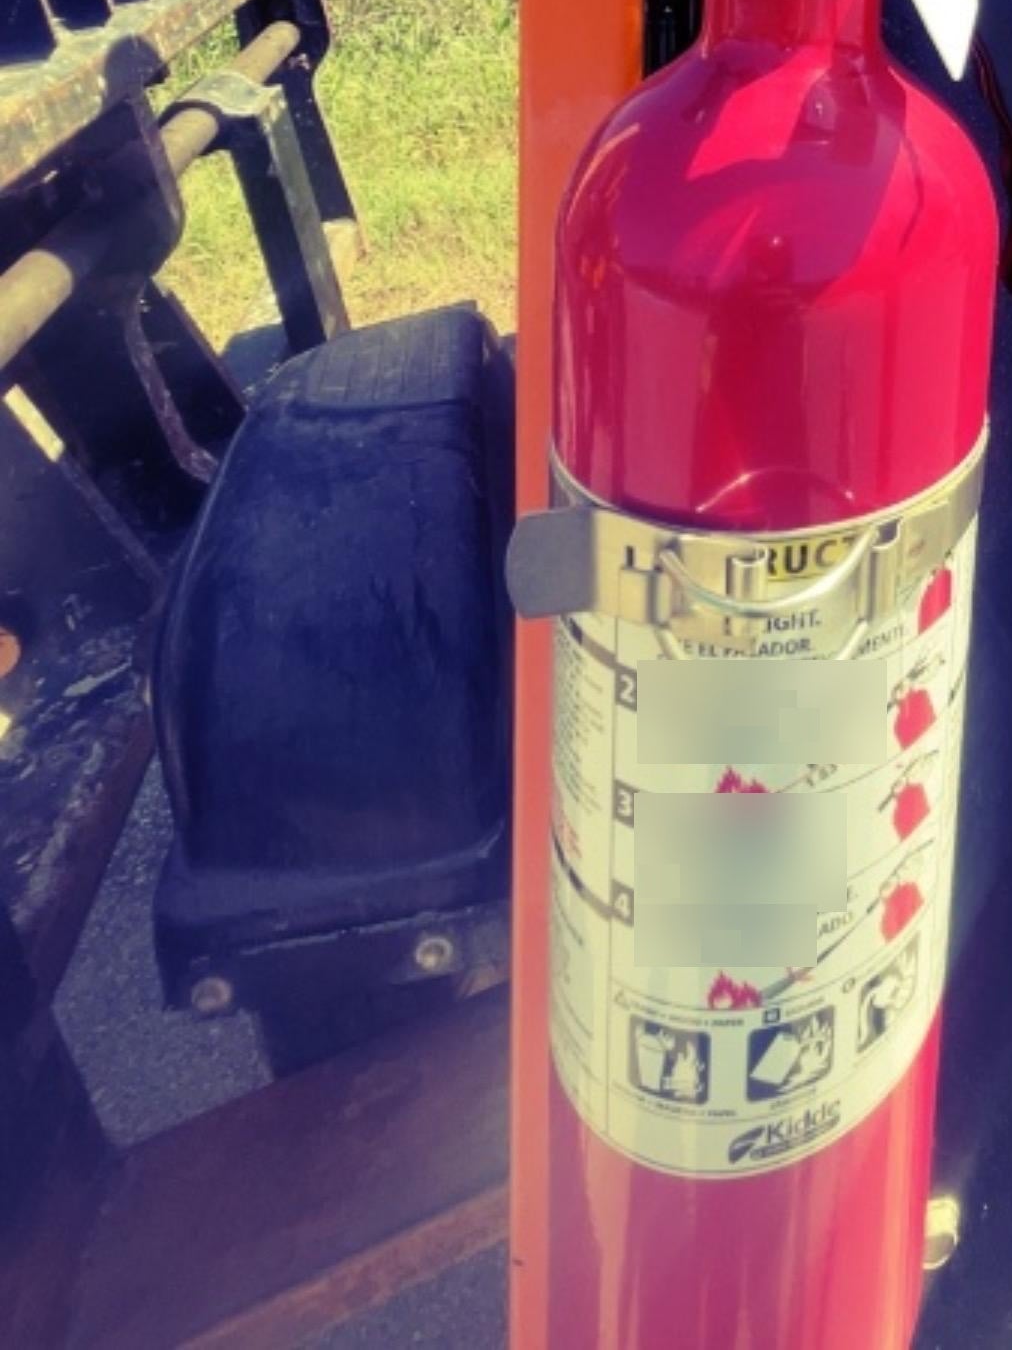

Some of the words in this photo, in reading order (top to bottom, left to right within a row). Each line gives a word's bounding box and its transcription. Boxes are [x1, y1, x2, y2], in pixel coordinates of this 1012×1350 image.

[620, 673, 636, 703] 2
[615, 788, 633, 817] 3
[613, 892, 630, 919] 4
